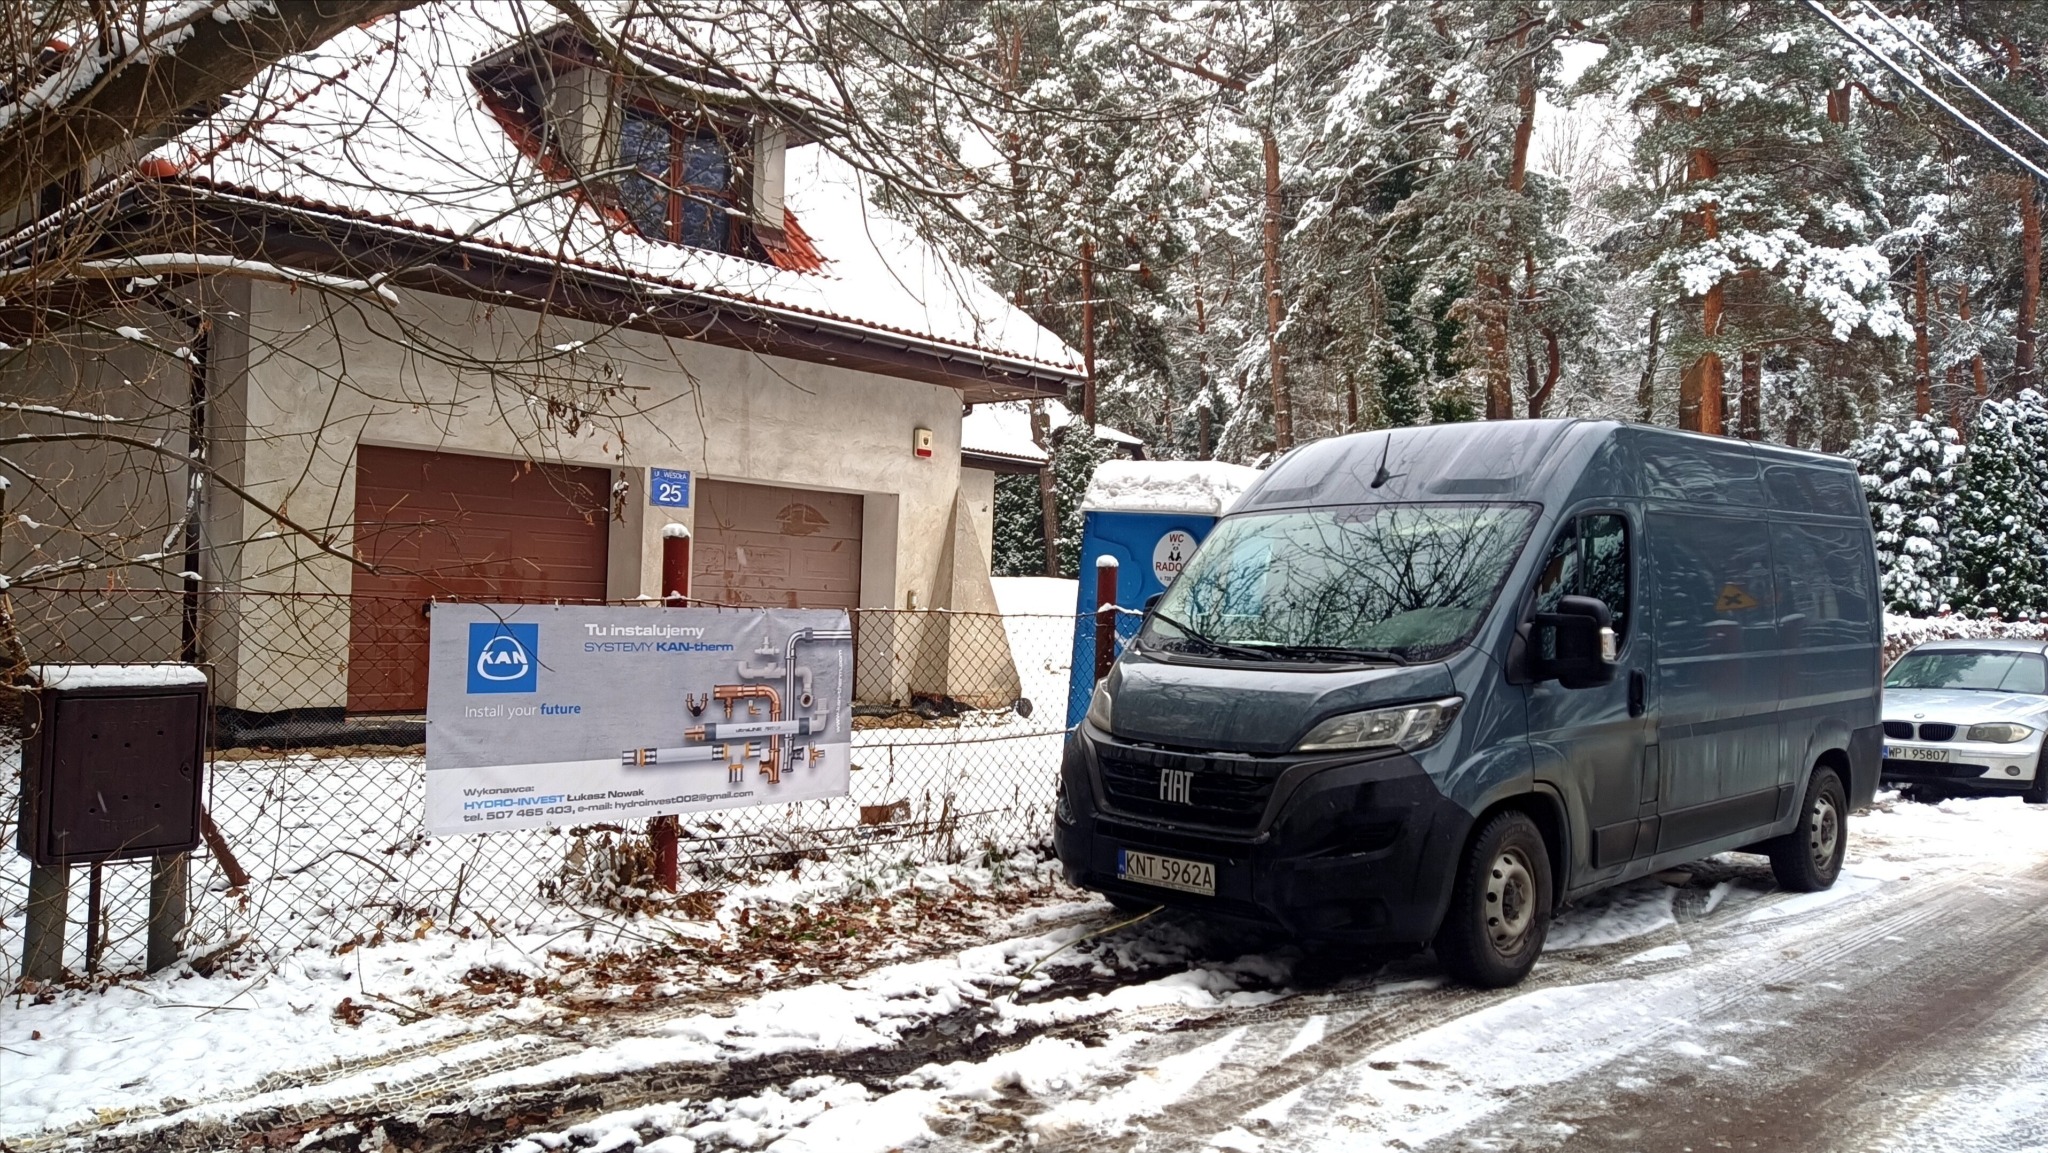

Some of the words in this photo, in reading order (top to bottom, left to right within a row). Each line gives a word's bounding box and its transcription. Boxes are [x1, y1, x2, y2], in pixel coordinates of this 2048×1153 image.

[659, 483, 682, 502] 25
[1170, 534, 1184, 543] WC
[584, 623, 607, 636] Tu
[610, 624, 705, 639] instalujemy
[584, 641, 653, 653] SYSTEMY
[656, 642, 734, 652] KAN-therm
[483, 651, 528, 665] KAN
[464, 704, 504, 718] Install
[507, 706, 537, 719] your
[540, 703, 582, 715] future
[1912, 748, 1947, 761] 95807
[463, 786, 535, 797] Wykonawca:
[1159, 768, 1194, 806] FIAT
[463, 814, 484, 822] tel.
[486, 810, 514, 820] 507
[516, 807, 544, 818] 465
[546, 805, 576, 815] 403,
[577, 802, 613, 812] e-mail:
[614, 790, 754, 809] hydroinvest002@gmail.com
[464, 794, 565, 810] HYDRO-INVEST
[566, 792, 606, 802] Łukasz
[607, 789, 644, 799] Nowak
[1126, 852, 1156, 878] KNT
[1161, 859, 1213, 888] 5962A
